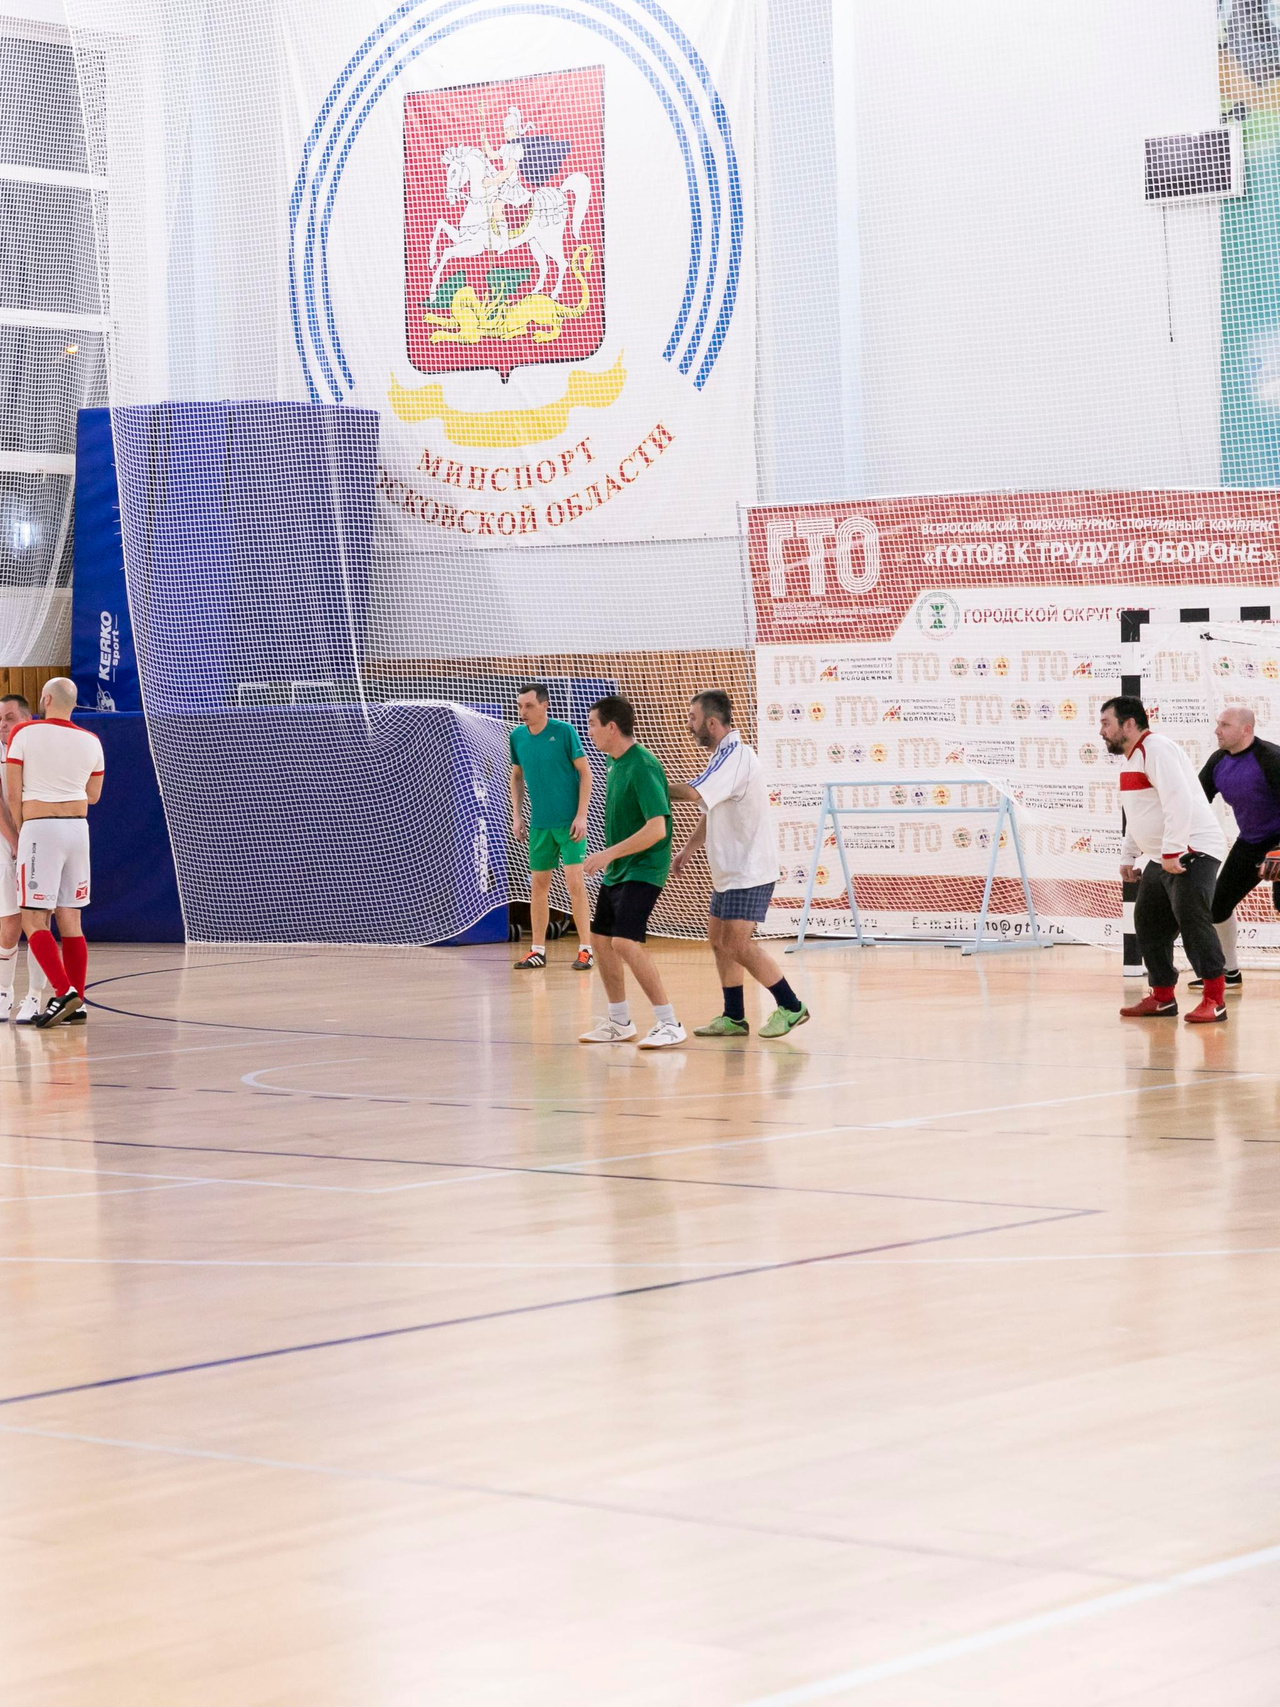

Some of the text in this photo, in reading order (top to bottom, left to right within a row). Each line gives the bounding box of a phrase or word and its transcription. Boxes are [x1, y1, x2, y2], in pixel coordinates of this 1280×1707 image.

[376, 419, 676, 535] ОСКОВСКОЙ ОБЛАСТИ
[417, 436, 596, 491] МИНСПОРТ
[1209, 519, 1276, 531] КОМПЛЕКС
[767, 517, 879, 597] ГТО
[922, 540, 1276, 566] «ГОТОВ К ТРУДУ И ОБОРОНЕ»
[963, 604, 1058, 624] ГОРОДСКОЙ
[1063, 606, 1112, 622] ОКРУГ
[98, 610, 113, 681] KERKO
[112, 629, 120, 667] sport
[973, 918, 1064, 937] ifo@gt.ru
